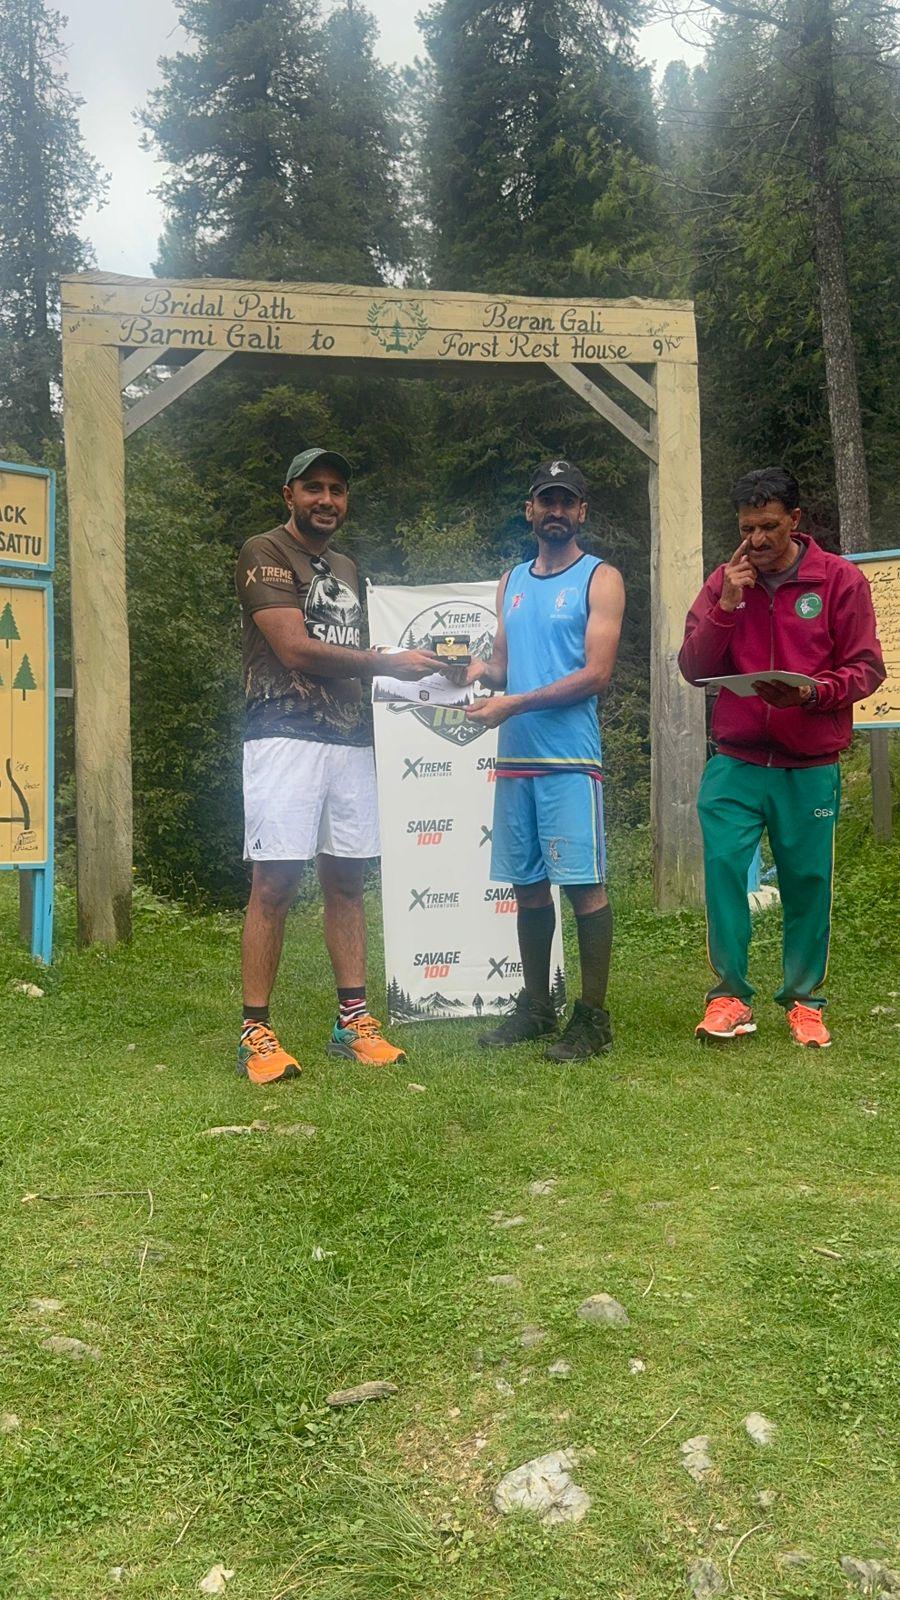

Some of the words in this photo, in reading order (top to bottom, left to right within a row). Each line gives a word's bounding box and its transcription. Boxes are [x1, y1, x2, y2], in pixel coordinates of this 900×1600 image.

[141, 288, 225, 317] Bridal
[233, 293, 296, 320] Path
[482, 302, 555, 331] Beran
[560, 308, 605, 333] Gali
[119, 317, 218, 346] Barmi
[226, 323, 283, 350] Gali
[307, 329, 335, 350] to
[438, 332, 501, 358] Forst
[506, 333, 560, 358] Rest
[569, 336, 633, 359] House
[313, 623, 360, 648] SAVAG
[401, 756, 452, 780] XTREME
[406, 818, 454, 834] SAVAGE
[416, 832, 443, 846] 100
[408, 886, 460, 912] XTREME
[413, 951, 461, 967] SAVAGE
[423, 964, 451, 979] 100
